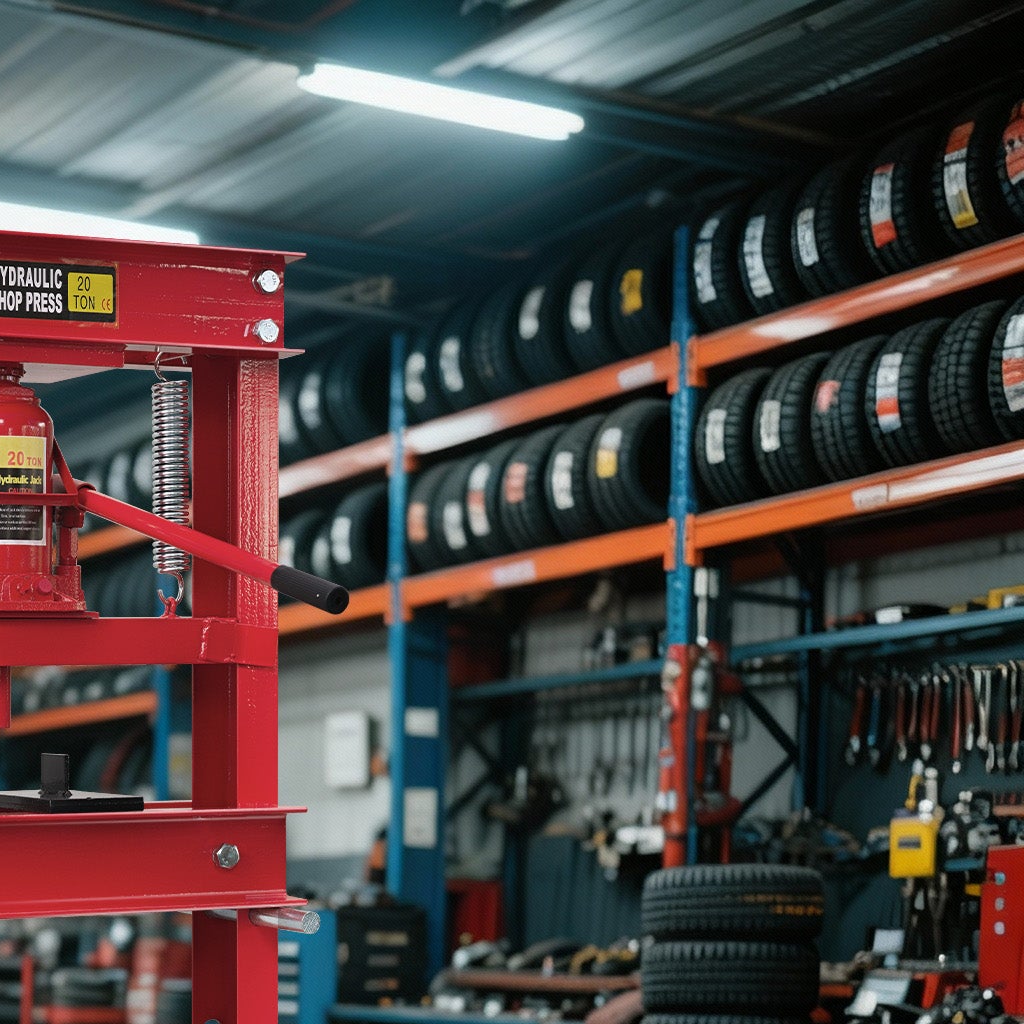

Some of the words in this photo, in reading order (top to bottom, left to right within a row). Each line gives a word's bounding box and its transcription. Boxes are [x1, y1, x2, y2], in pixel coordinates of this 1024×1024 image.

[77, 275, 91, 292] 20
[25, 291, 63, 314] PRESS
[73, 294, 96, 310] TON
[101, 298, 111, 311] CE
[7, 450, 25, 466] 20
[26, 456, 42, 467] TON
